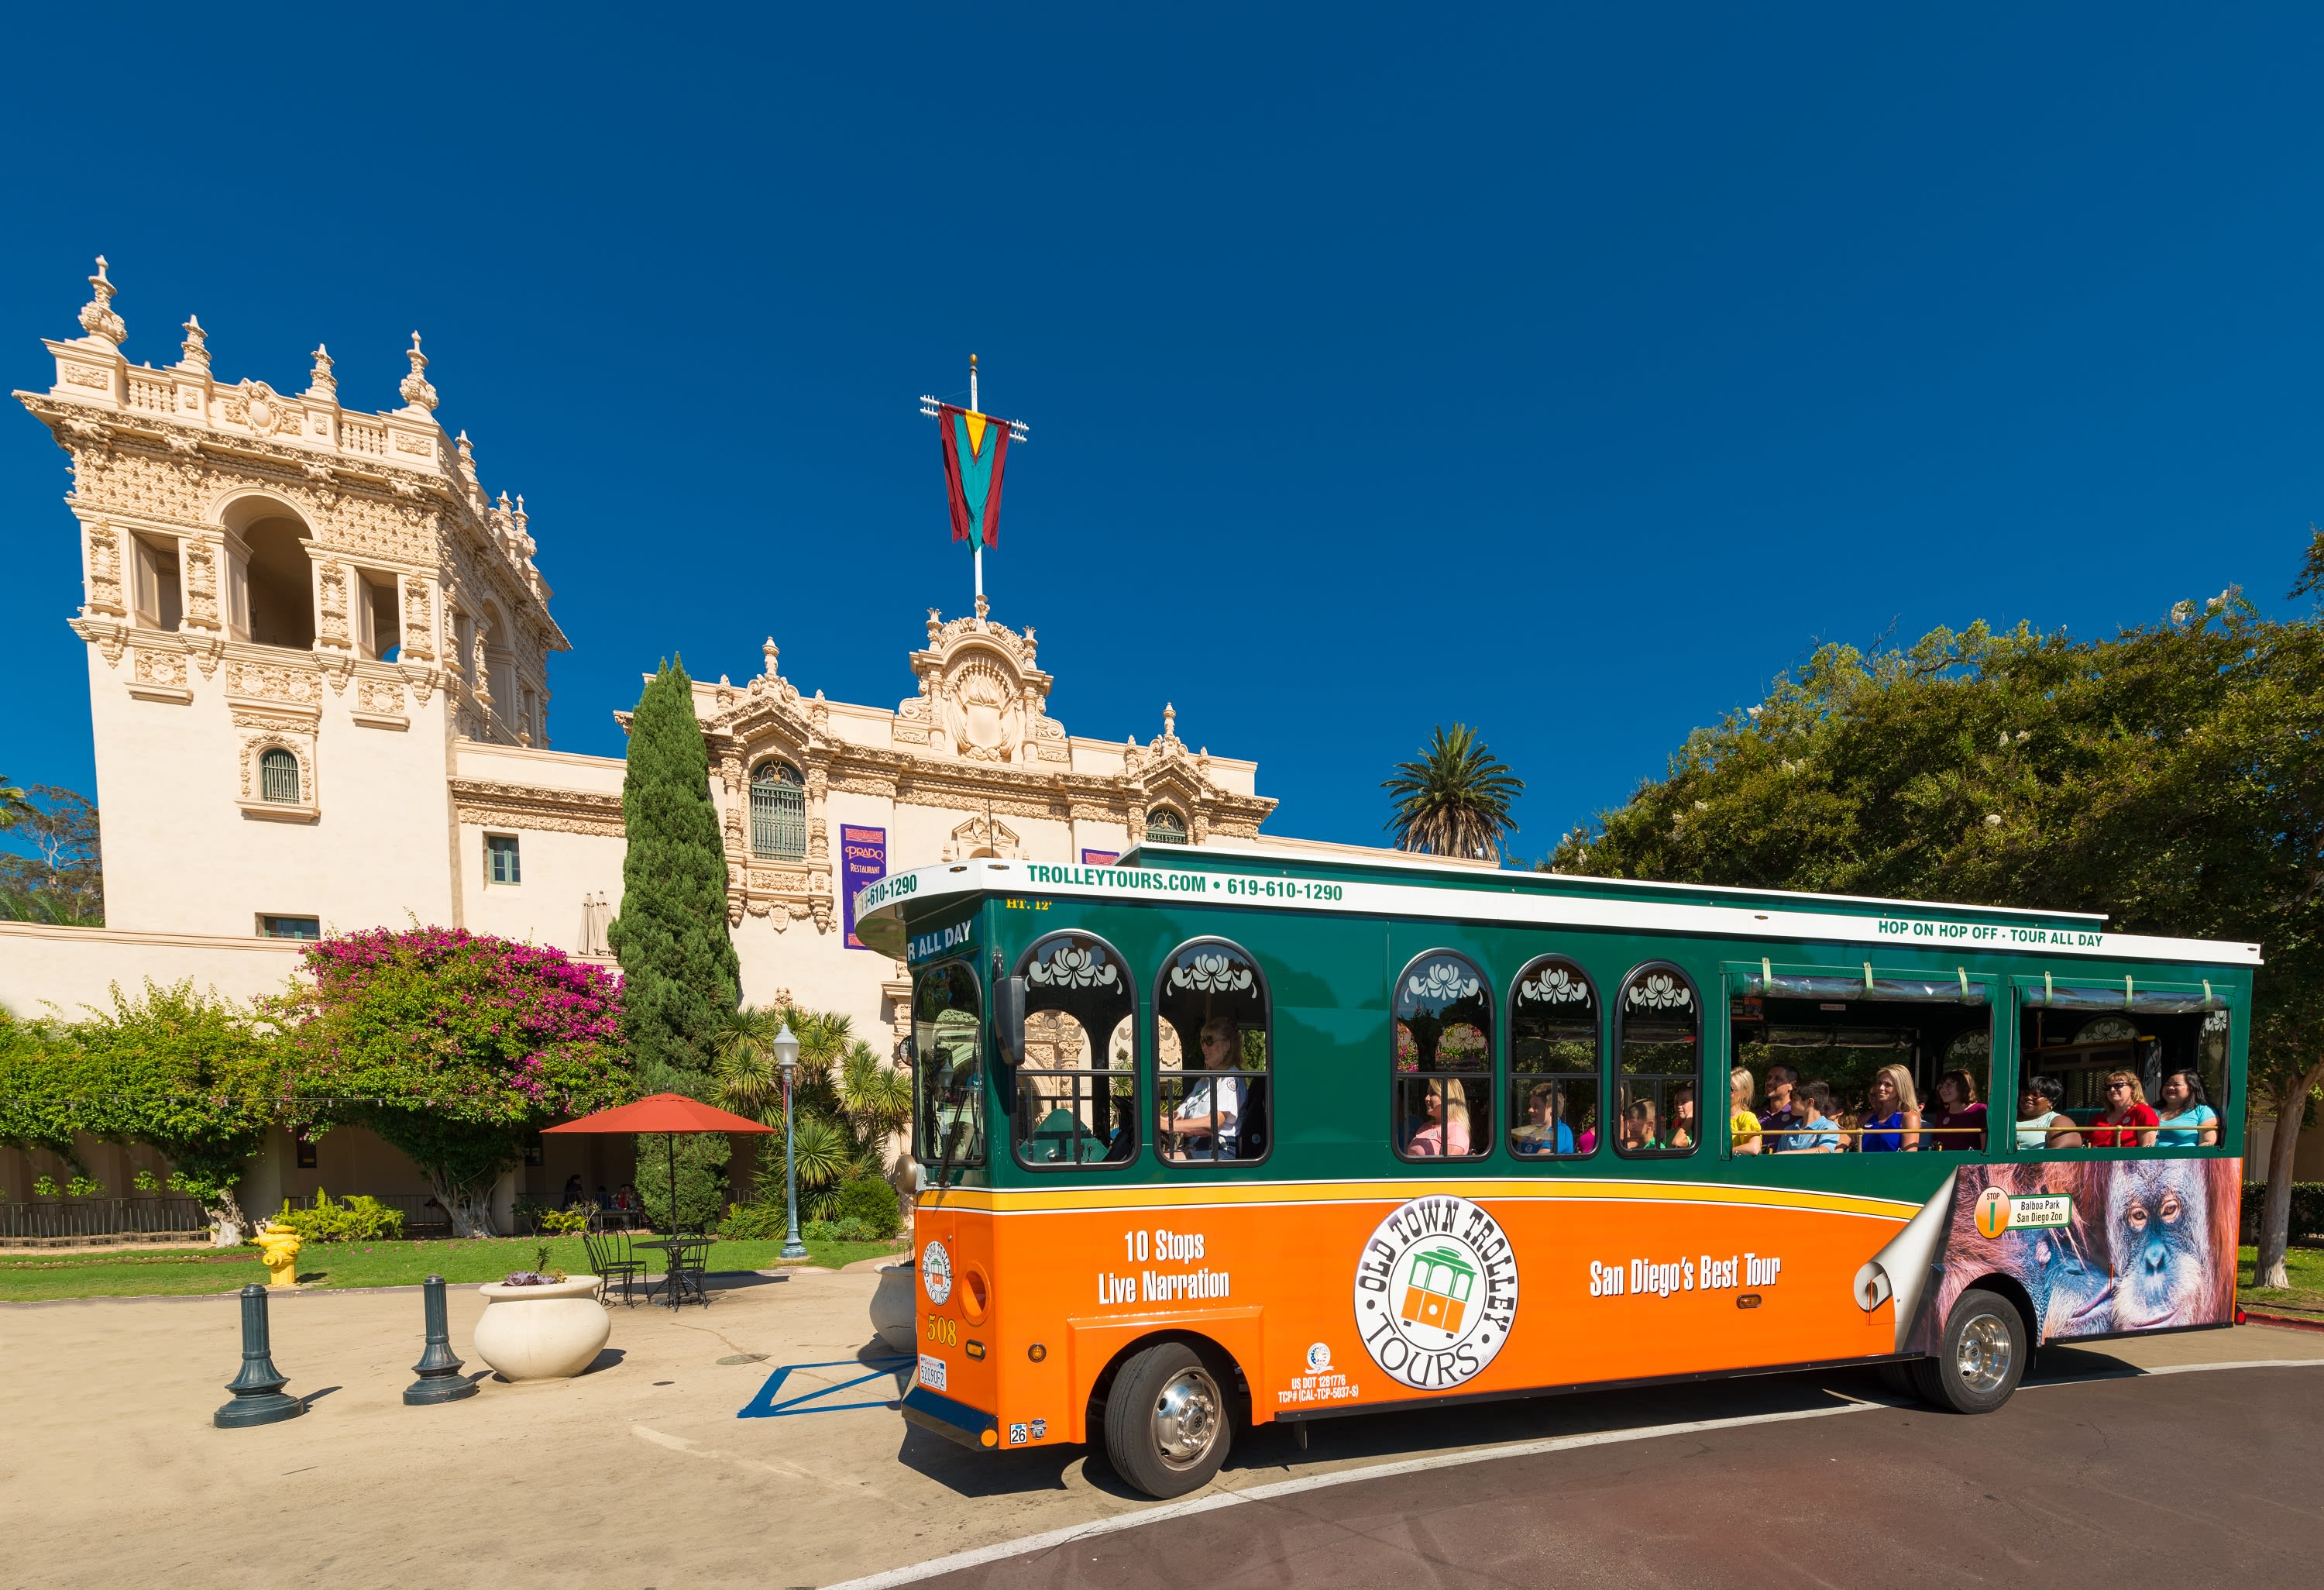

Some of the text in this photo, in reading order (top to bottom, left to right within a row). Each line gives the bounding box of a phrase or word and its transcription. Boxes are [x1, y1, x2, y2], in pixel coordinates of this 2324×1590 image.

[845, 846, 885, 864] PRADO
[1026, 864, 1343, 902] TROLLEYTOURS.COM 619-610-1290
[1006, 899, 1031, 910] HT.
[918, 932, 942, 958] ALL
[944, 919, 971, 948] DAY
[1879, 920, 2103, 947] HOP ON HOP OFF TOUR ALL DAY
[2016, 1211, 2063, 1223] San Diego Zoo
[2020, 1199, 2061, 1211] Balboa Park
[1124, 1229, 1205, 1265] 10 Stops
[1357, 1199, 1515, 1332] OLD TOWN TROLLEY
[1590, 1252, 1781, 1298] San Diego's Best Tour
[1098, 1268, 1230, 1305] Live Narration
[927, 1313, 957, 1347] 508
[1277, 1384, 1359, 1403] TCP# (CAL-TCP-5037-S)
[1291, 1374, 1346, 1389] US DOT 1281776
[1011, 1428, 1026, 1443] 26
